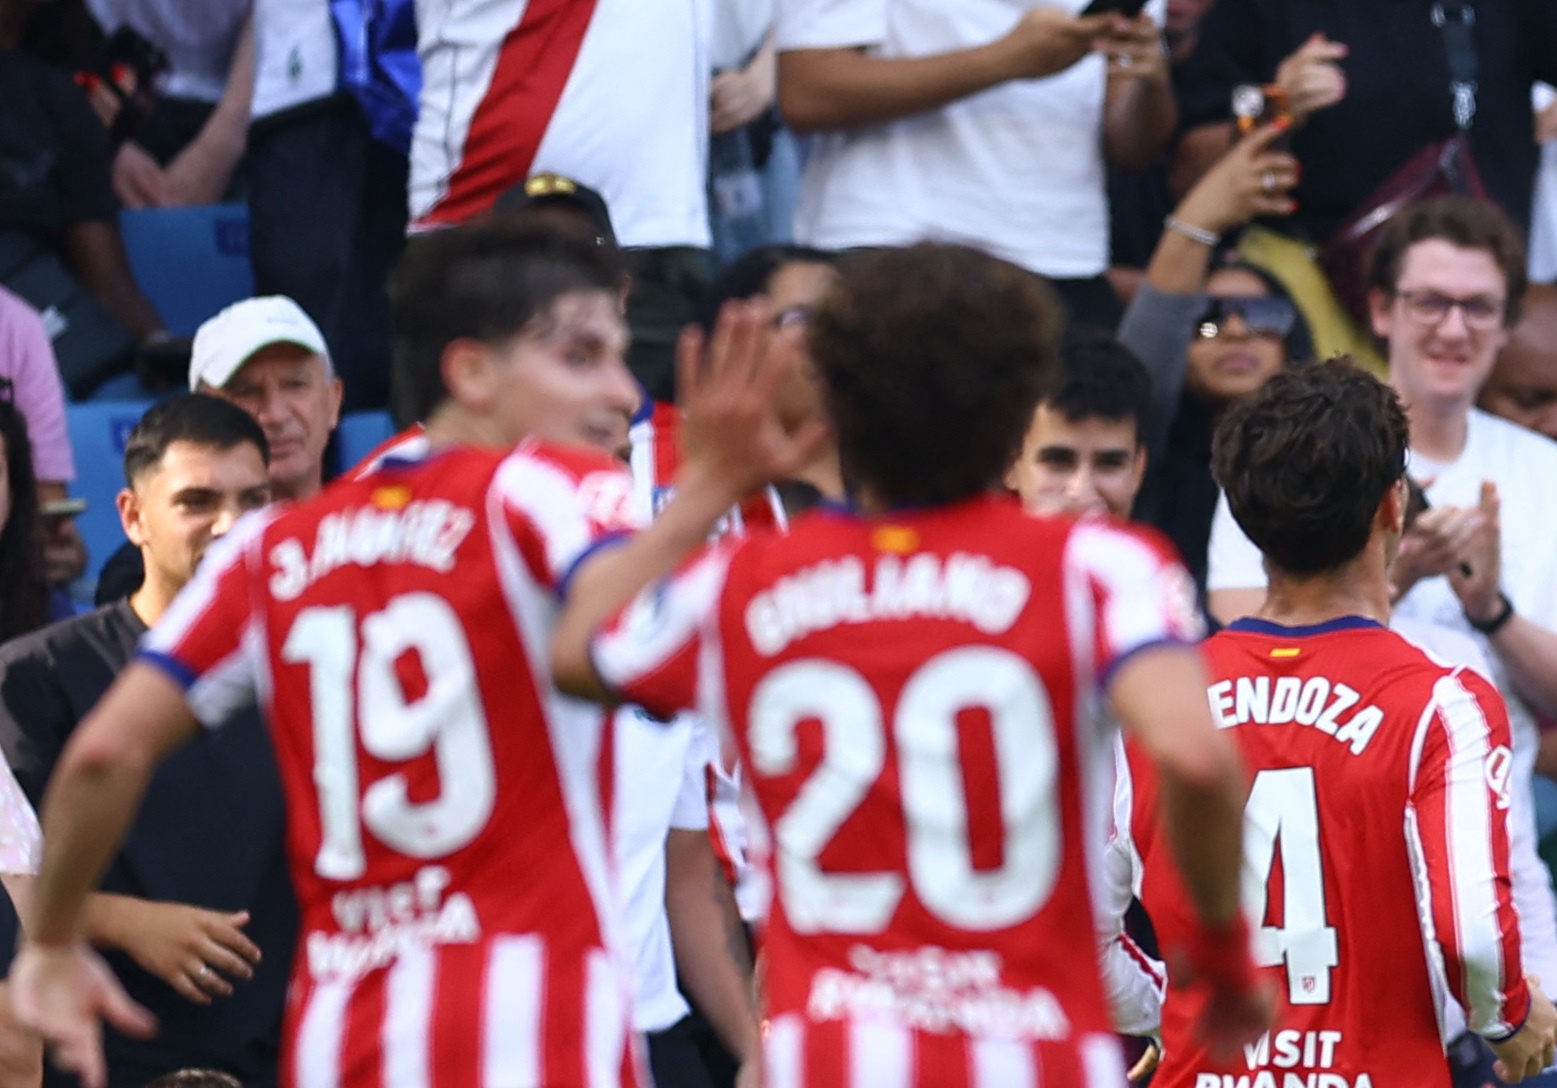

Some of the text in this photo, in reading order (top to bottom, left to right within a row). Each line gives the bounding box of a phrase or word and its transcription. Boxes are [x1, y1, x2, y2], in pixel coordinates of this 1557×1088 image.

[281, 591, 496, 880] 19
[747, 645, 1062, 934] 20
[1207, 676, 1385, 756] ENDOZA
[1241, 767, 1338, 1004] 4
